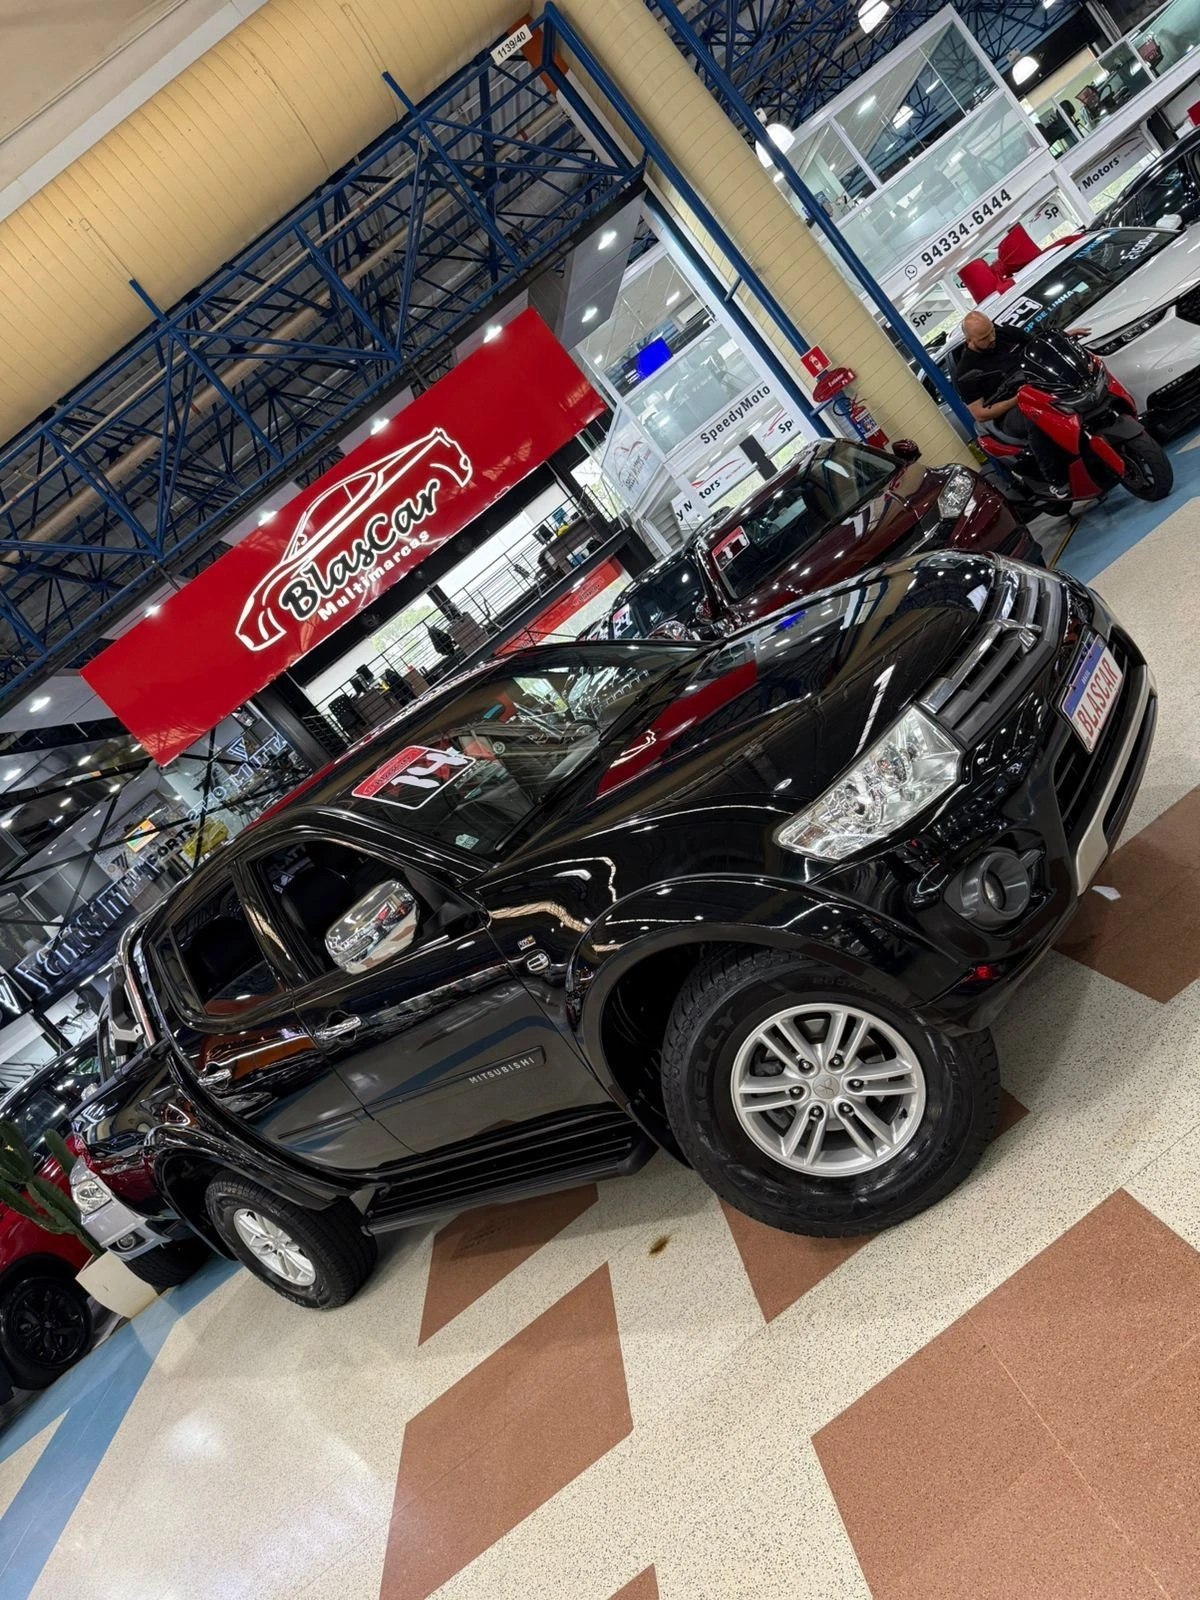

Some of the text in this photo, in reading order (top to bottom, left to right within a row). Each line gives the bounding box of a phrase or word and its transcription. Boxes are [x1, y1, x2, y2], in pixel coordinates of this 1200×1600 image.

[497, 31, 527, 58] 1139/40
[921, 188, 1012, 267] 94334-6444
[1035, 312, 1048, 323] DE
[1049, 290, 1075, 312] LINHA
[700, 385, 771, 444] SpeedyMoto
[279, 479, 440, 621] BlasCar
[317, 530, 430, 622] Multimarcas
[1077, 656, 1119, 738] BLASCAR
[391, 752, 469, 789] 14
[467, 1056, 536, 1085] MITSUBISHI
